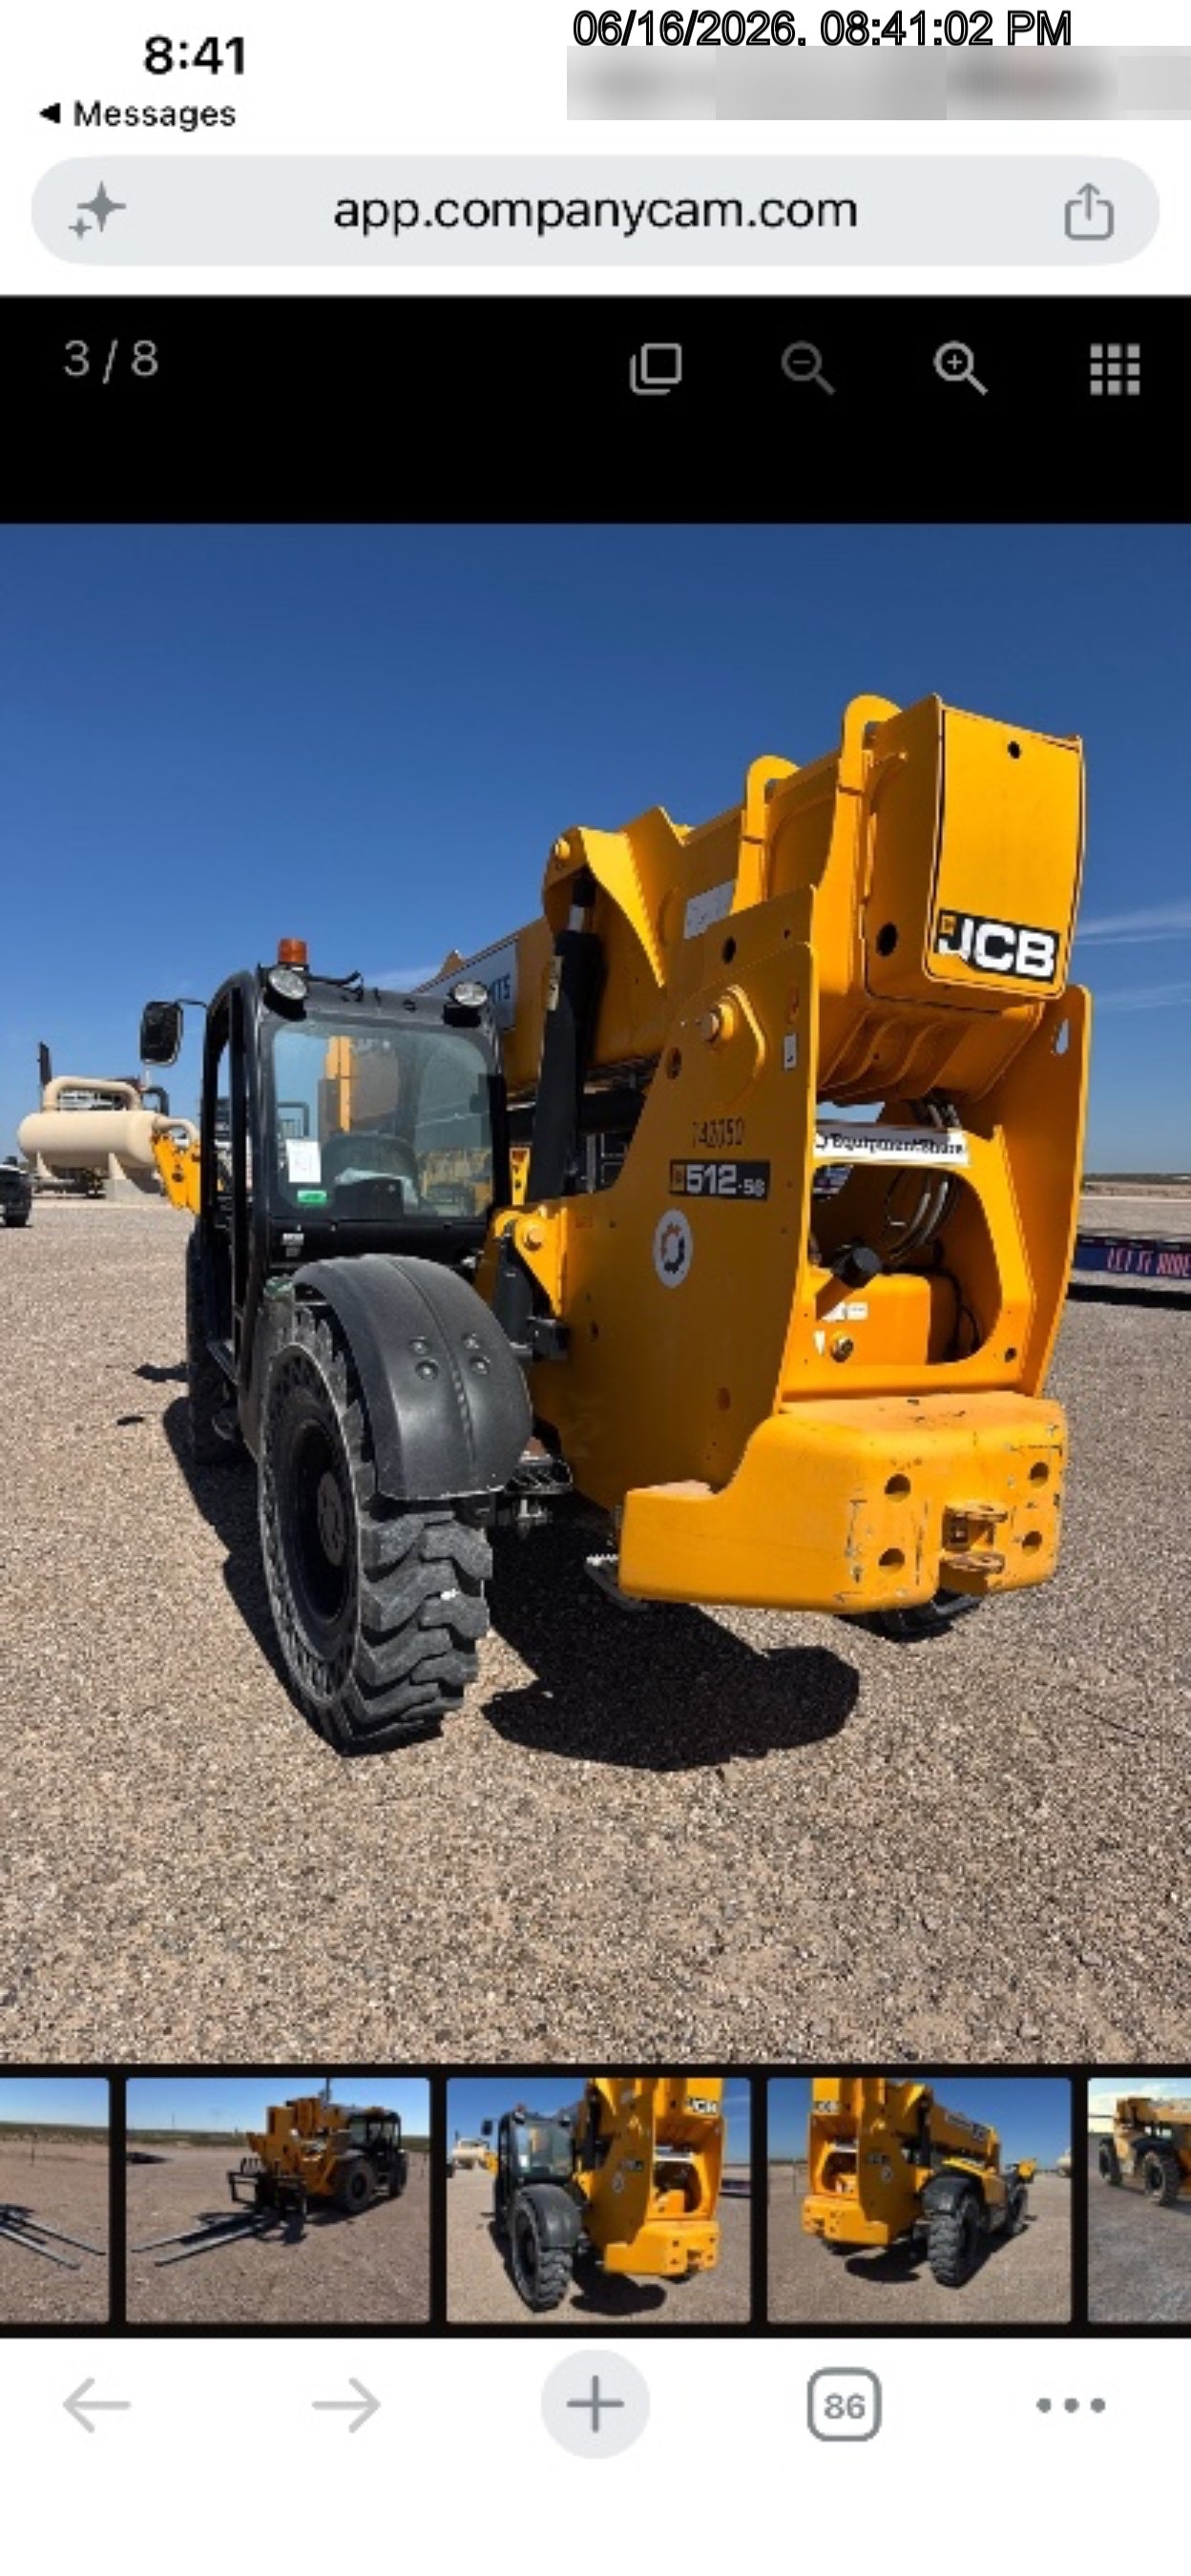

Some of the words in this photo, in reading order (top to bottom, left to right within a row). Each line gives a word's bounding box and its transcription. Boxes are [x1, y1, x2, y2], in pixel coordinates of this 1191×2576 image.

[143, 34, 245, 76] 8:41
[73, 99, 237, 134] Messages
[333, 197, 859, 239] app.companycam.com
[64, 340, 91, 380] 3
[132, 340, 159, 380] 8
[938, 917, 1056, 978] JCB
[823, 2393, 867, 2420] 86
